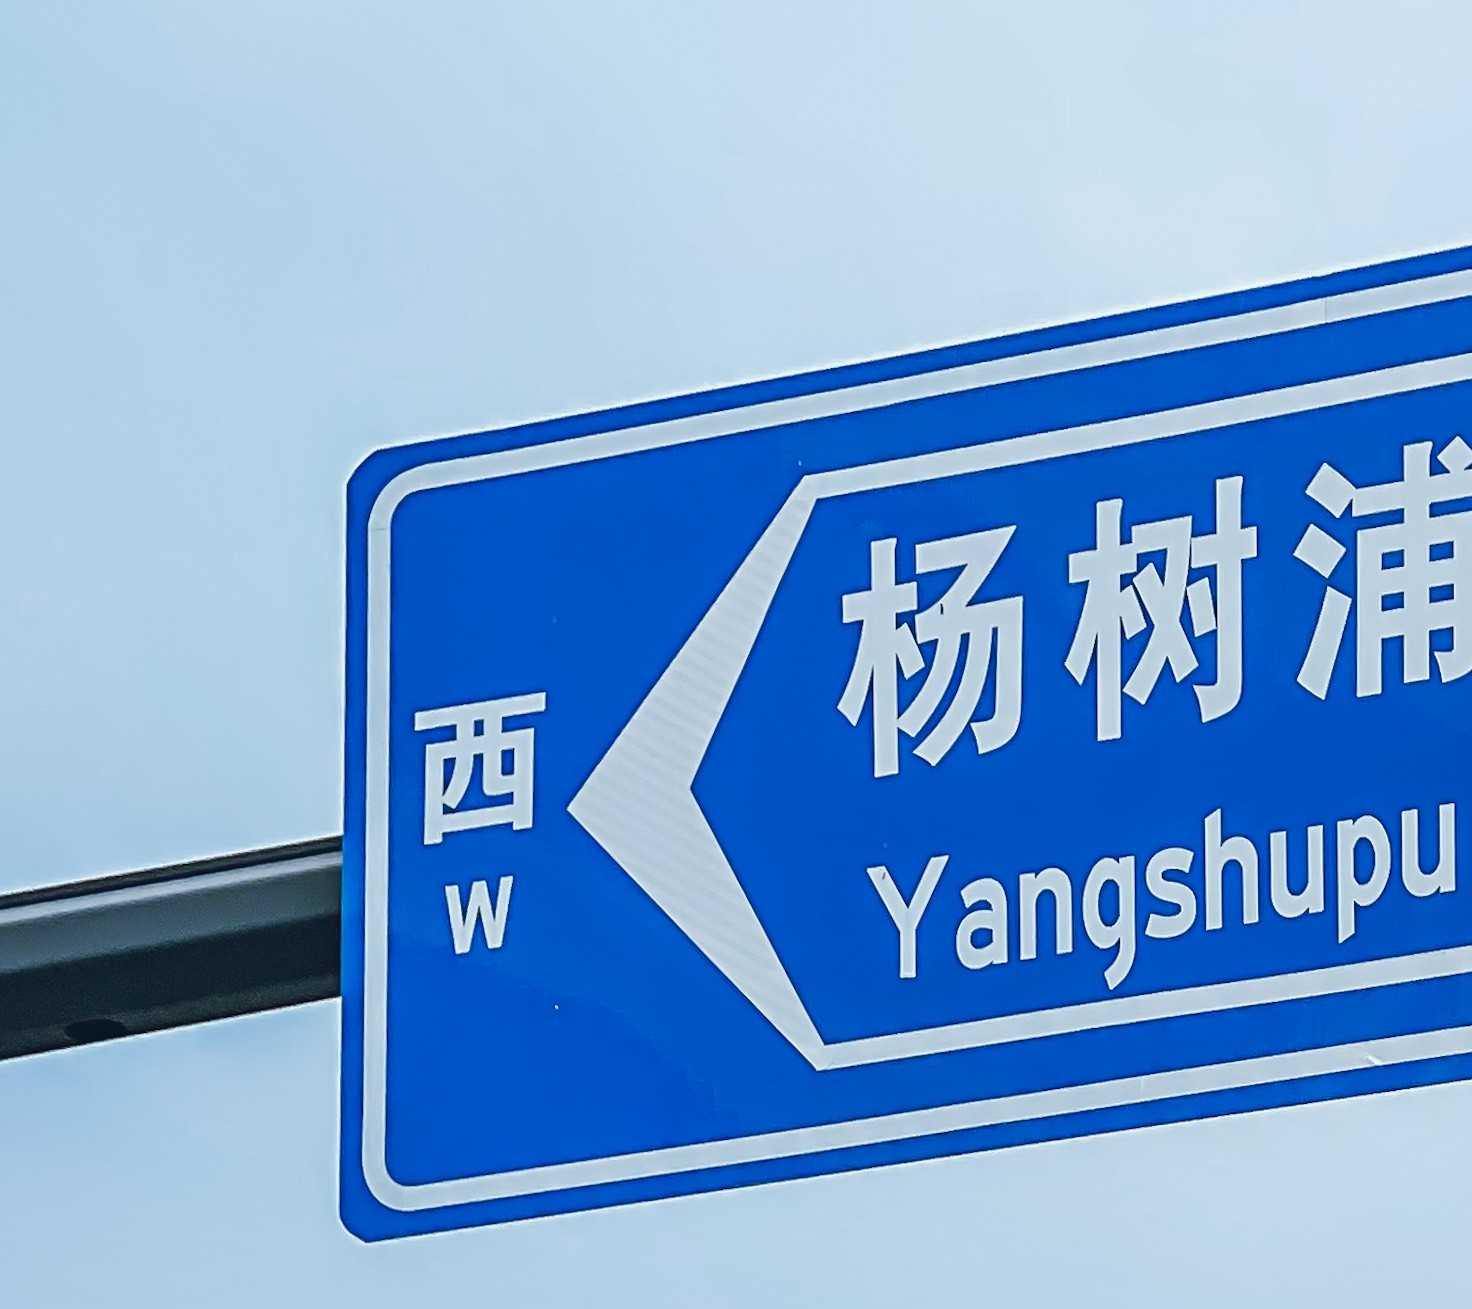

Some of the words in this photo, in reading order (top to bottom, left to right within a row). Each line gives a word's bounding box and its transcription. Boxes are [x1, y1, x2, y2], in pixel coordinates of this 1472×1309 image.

[414, 691, 547, 846] 西
[443, 875, 515, 956] W
[866, 802, 1458, 990] Yangshupu
